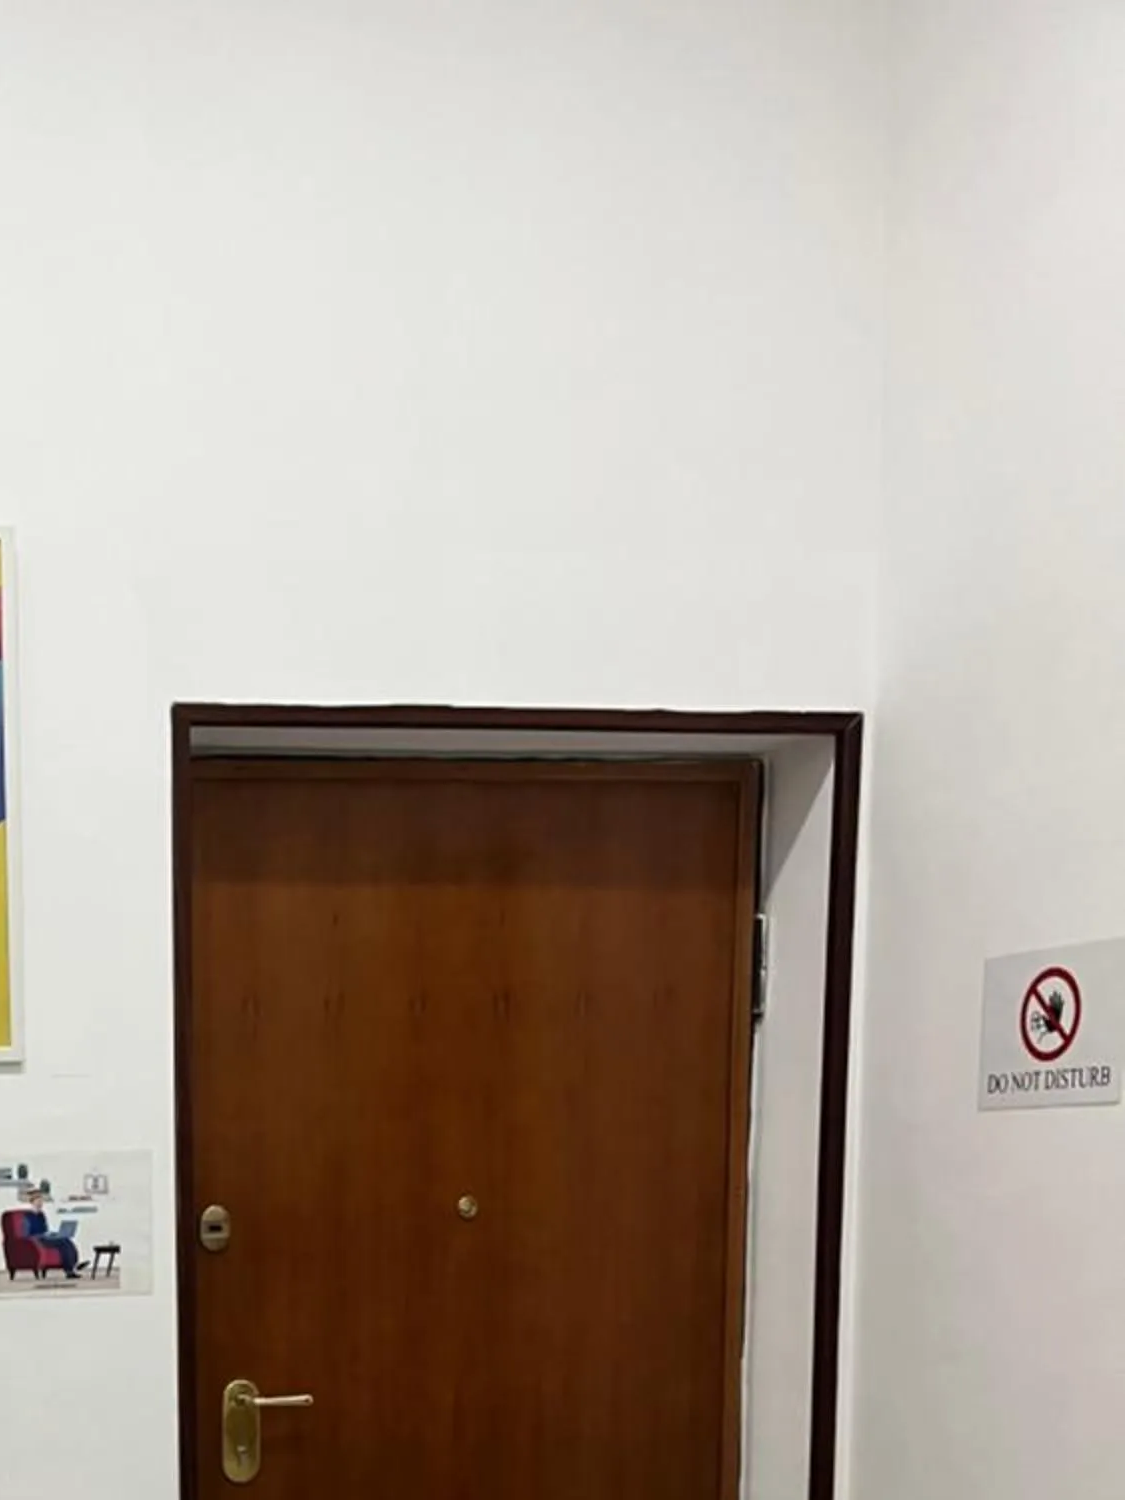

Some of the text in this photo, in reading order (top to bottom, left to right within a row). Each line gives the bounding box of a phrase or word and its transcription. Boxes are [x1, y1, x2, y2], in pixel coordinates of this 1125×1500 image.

[987, 1066, 1111, 1094] DO NOT DISTURB
